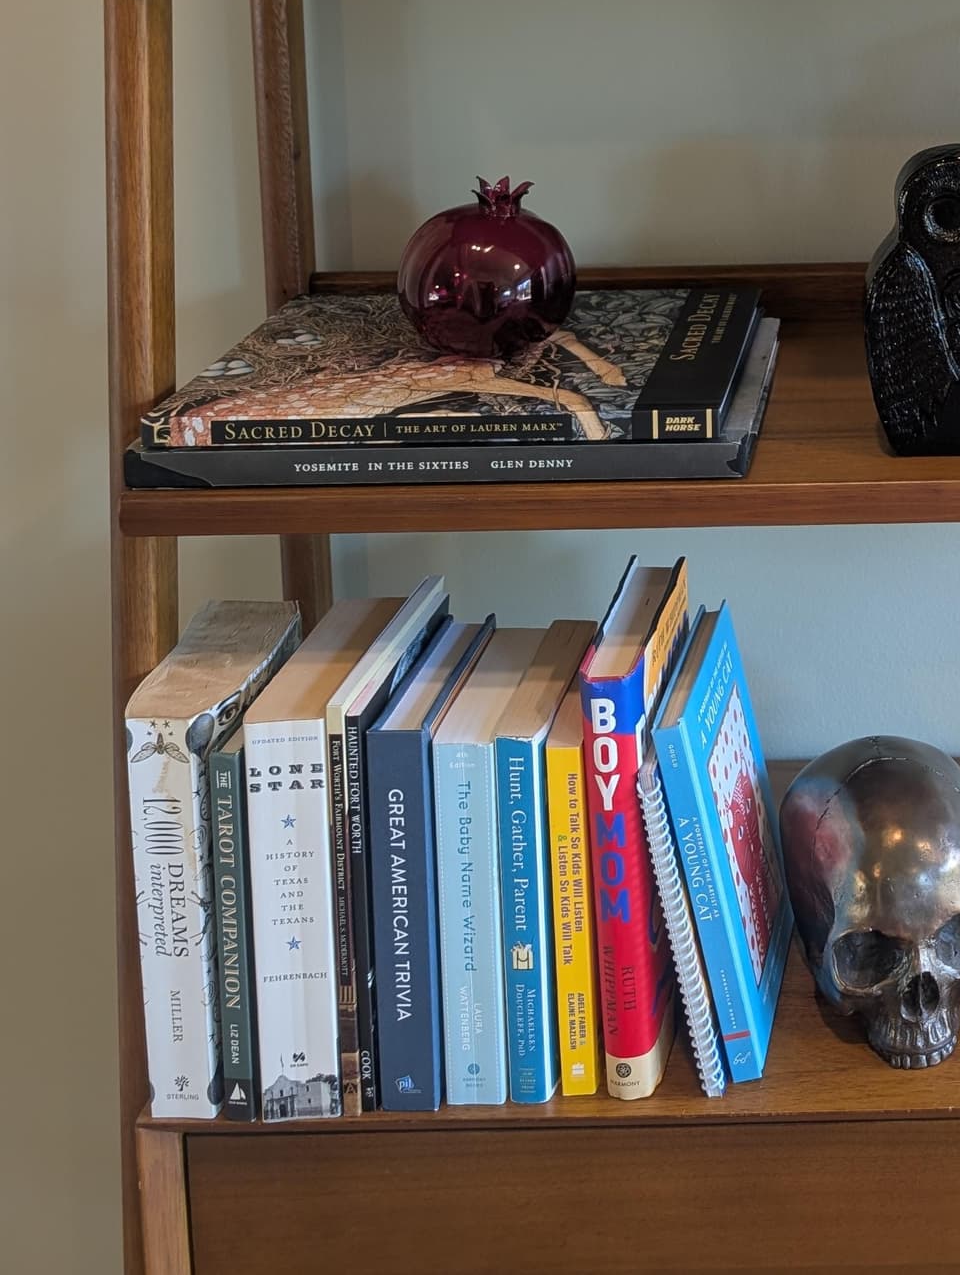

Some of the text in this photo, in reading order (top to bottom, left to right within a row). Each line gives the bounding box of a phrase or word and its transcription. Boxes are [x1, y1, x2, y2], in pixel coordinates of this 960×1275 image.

[225, 421, 374, 440] SACRED DECAY
[294, 461, 469, 473] YOSEMITE IN THE SIXTIES
[490, 458, 573, 470] GLEN DENNY
[249, 764, 323, 777] LONE
[249, 780, 326, 793] STAR
[348, 727, 361, 853] HAUNTED FORT WORTH
[589, 698, 617, 811] BOY
[142, 796, 181, 856] 12,000
[267, 850, 314, 859] HISTORY
[502, 757, 528, 931] Hunt, Gather, Parent
[567, 773, 584, 932] How to Talk So Kids Will Listen
[216, 795, 242, 1009] TAROT COMPANION
[274, 877, 309, 885] TEXAS
[388, 788, 413, 1022] GREAT AMERICAN TRIVIA
[456, 781, 477, 972] The Baby Name Wizard
[594, 813, 627, 922] MOM
[148, 864, 171, 957] interpreted
[167, 863, 190, 959] DREAMS
[272, 916, 314, 925] TEXANS
[264, 971, 327, 983] FEHRENBACH
